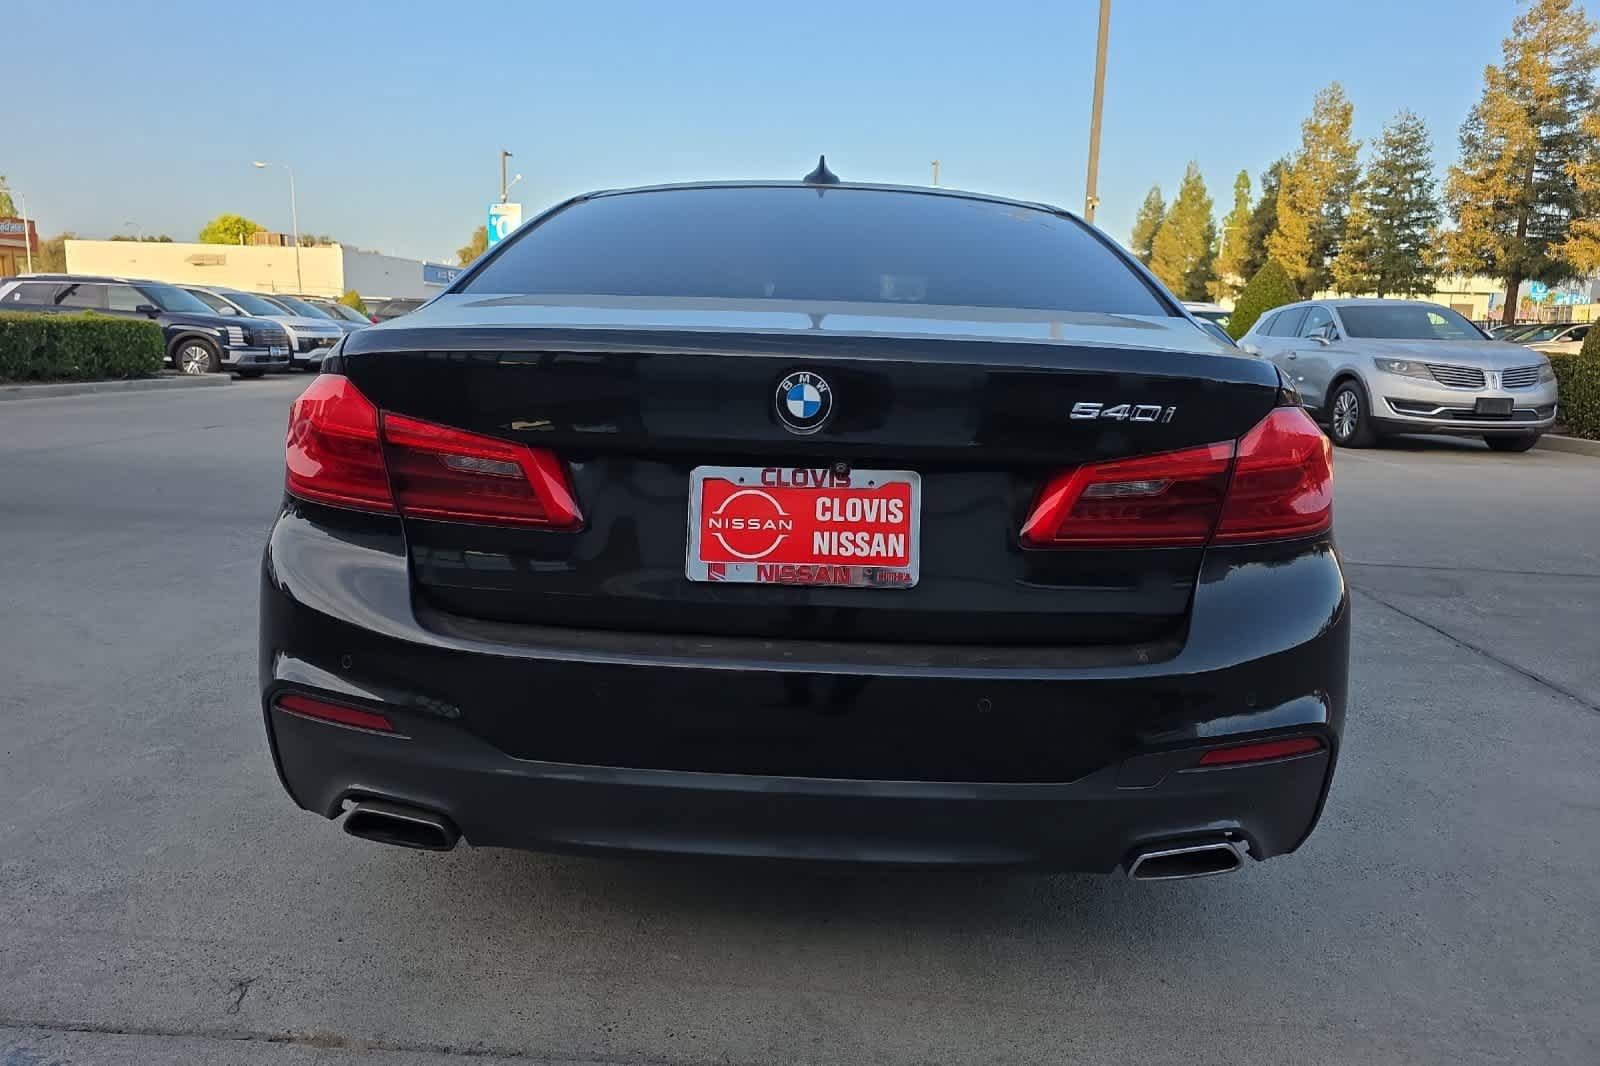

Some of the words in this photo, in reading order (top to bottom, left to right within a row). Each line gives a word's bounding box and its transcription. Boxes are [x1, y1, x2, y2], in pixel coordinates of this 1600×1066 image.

[782, 374, 827, 392] BMW
[1069, 402, 1177, 423] 540i
[761, 467, 851, 488] CLOVIS
[815, 497, 904, 523] CLOVIS
[708, 518, 793, 531] NISSAN
[813, 531, 905, 558] NISSAN
[757, 564, 850, 585] NISSAN
